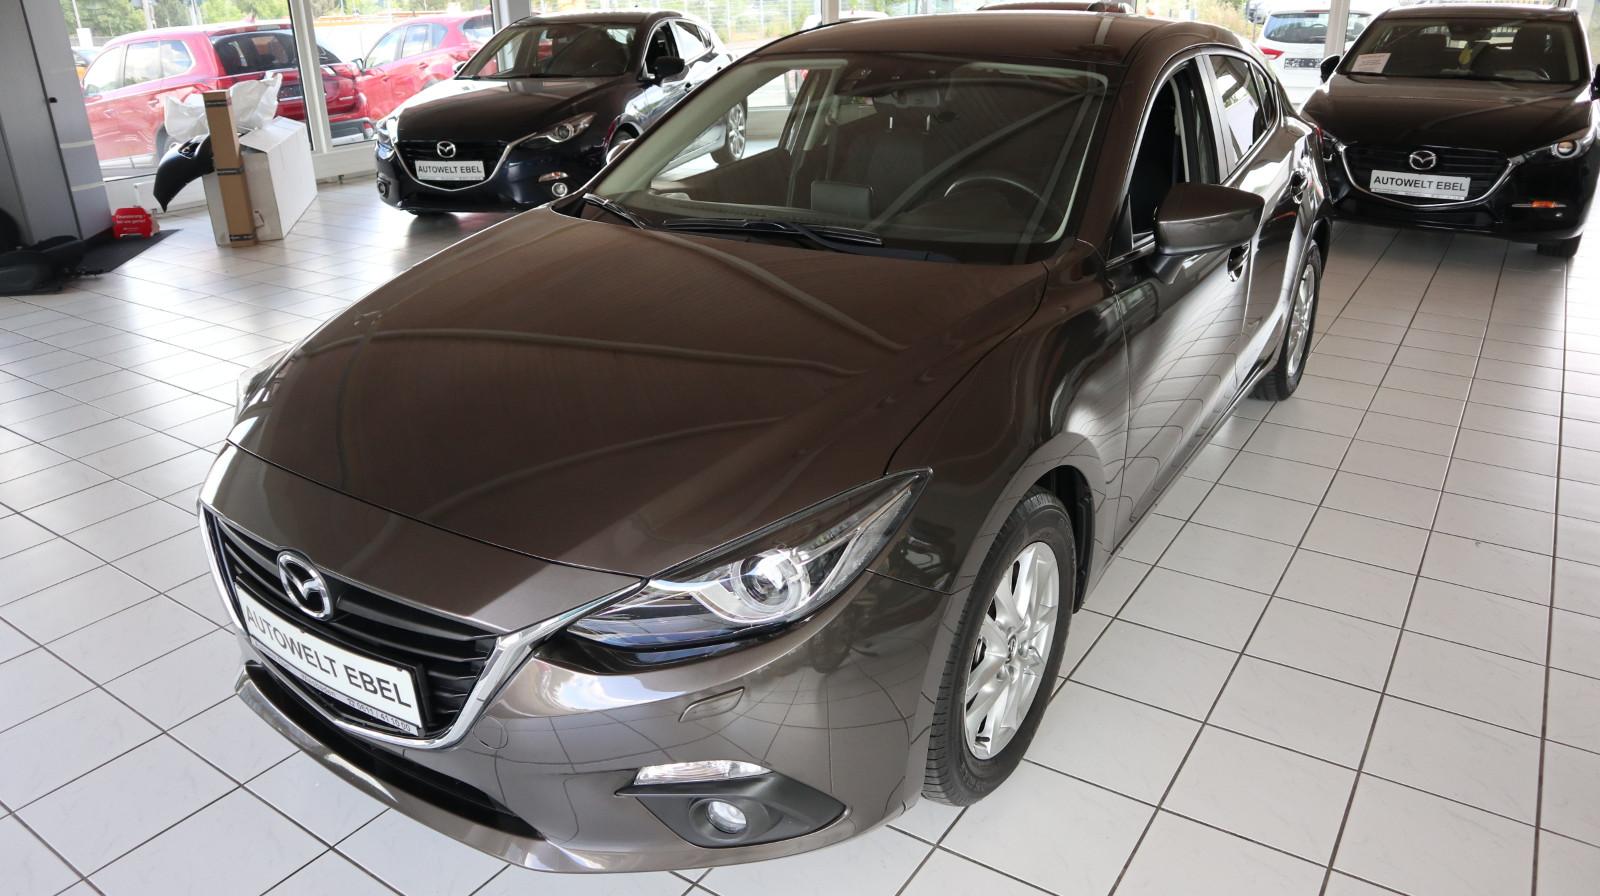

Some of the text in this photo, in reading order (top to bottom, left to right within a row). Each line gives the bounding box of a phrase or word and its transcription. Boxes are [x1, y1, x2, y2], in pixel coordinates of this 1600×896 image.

[418, 166, 482, 174] AUTOWELT EBEL
[1373, 175, 1466, 192] AUTOWELT EBEL
[245, 604, 340, 679] AUTOWELT
[343, 663, 412, 709] EBEL
